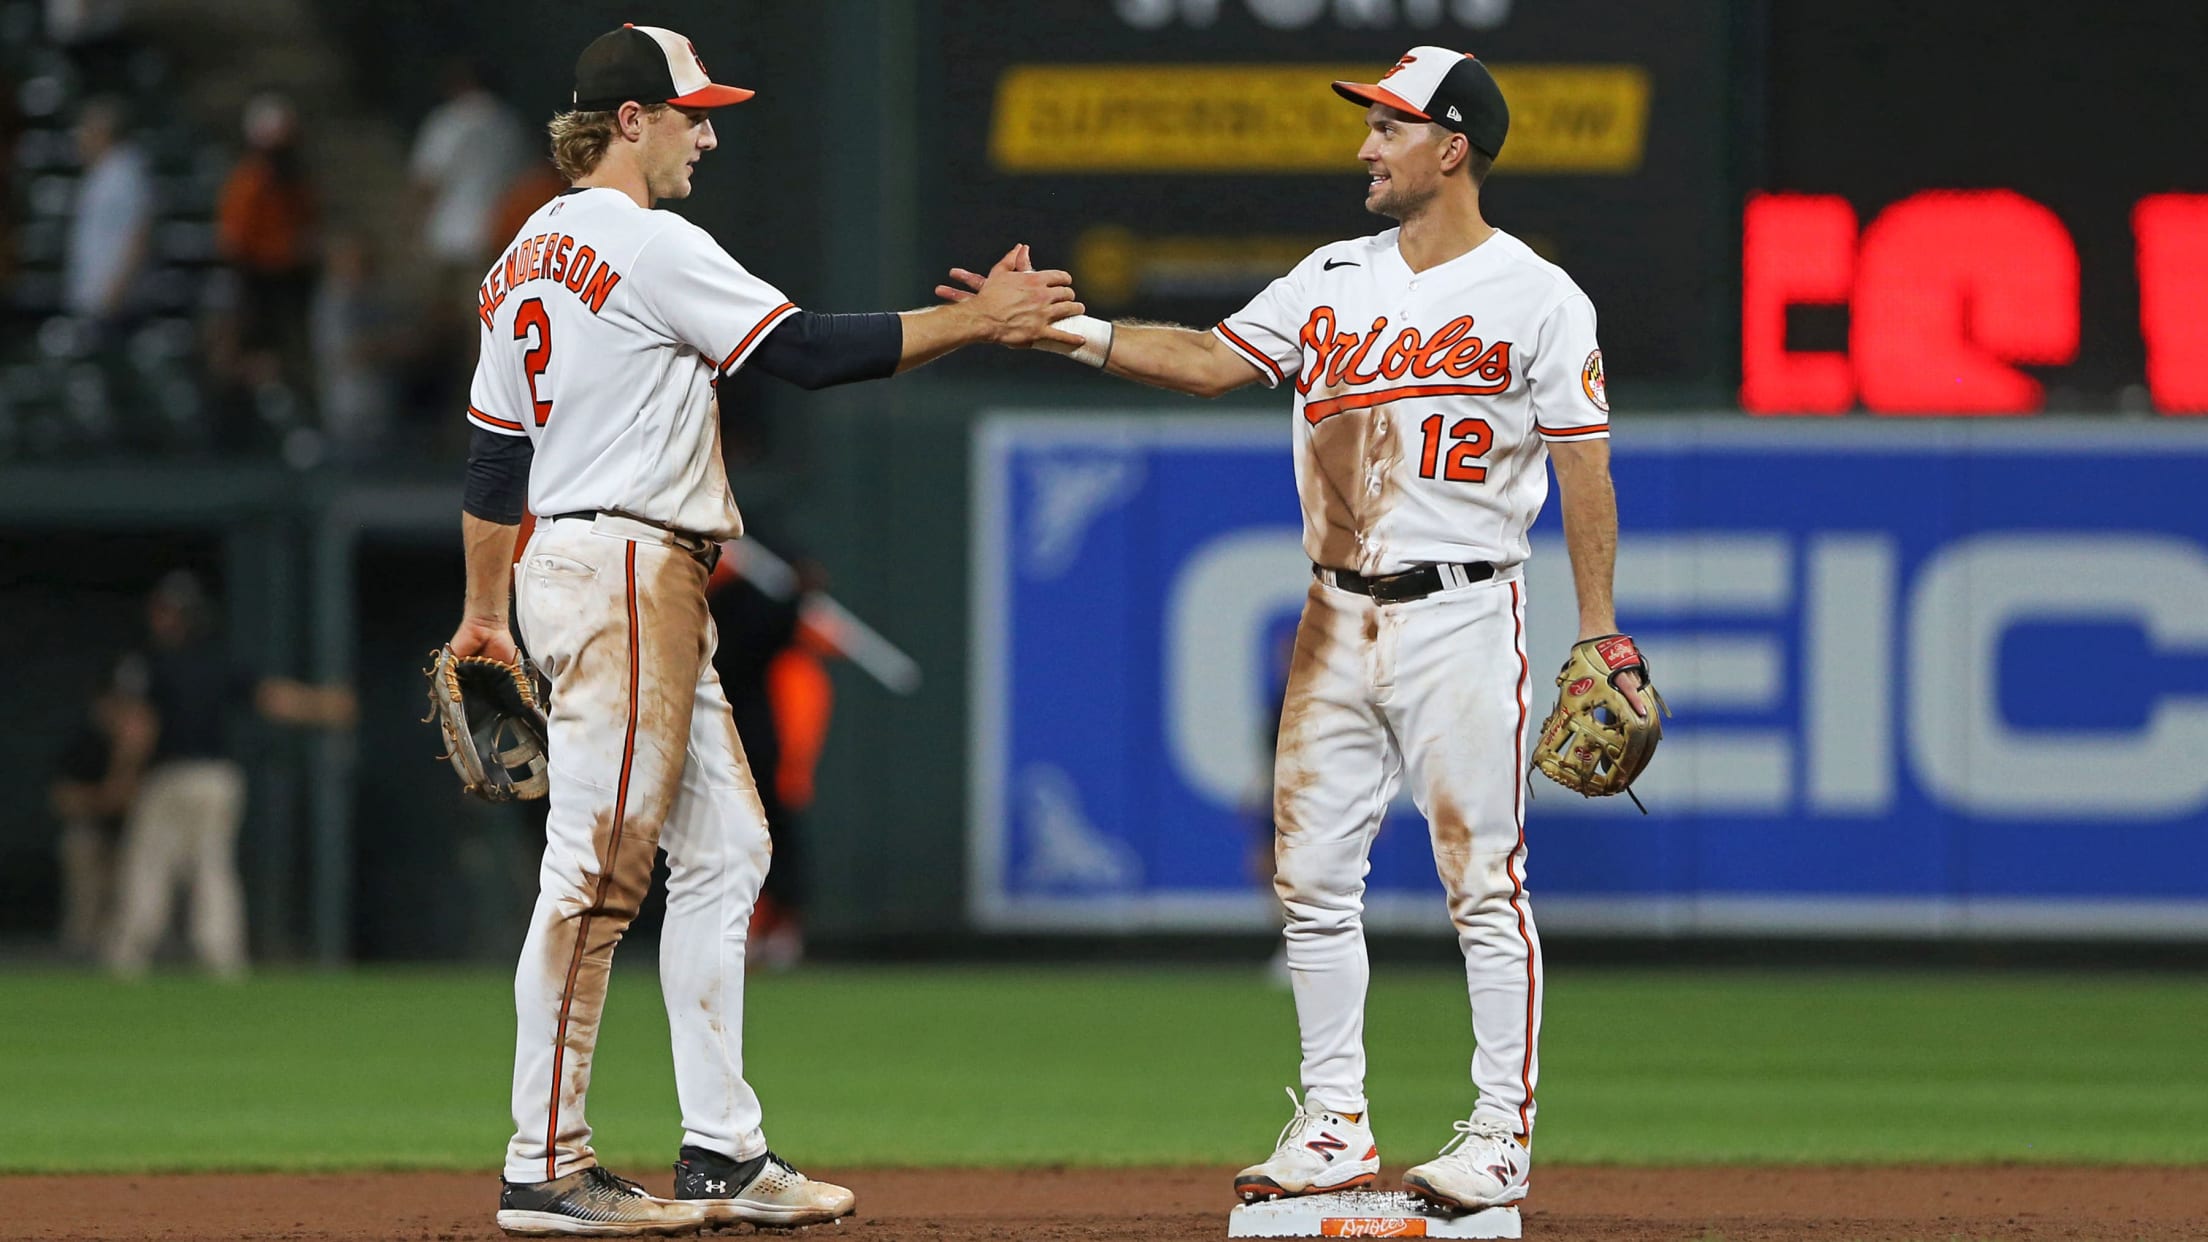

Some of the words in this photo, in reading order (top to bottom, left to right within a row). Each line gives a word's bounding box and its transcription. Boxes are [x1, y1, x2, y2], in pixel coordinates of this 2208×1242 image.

[479, 232, 621, 332] HENDERSON
[513, 297, 553, 427] 2
[1295, 305, 1513, 398] Orioles
[1419, 413, 1494, 483] 12
[1339, 1216, 1408, 1238] Orioles
